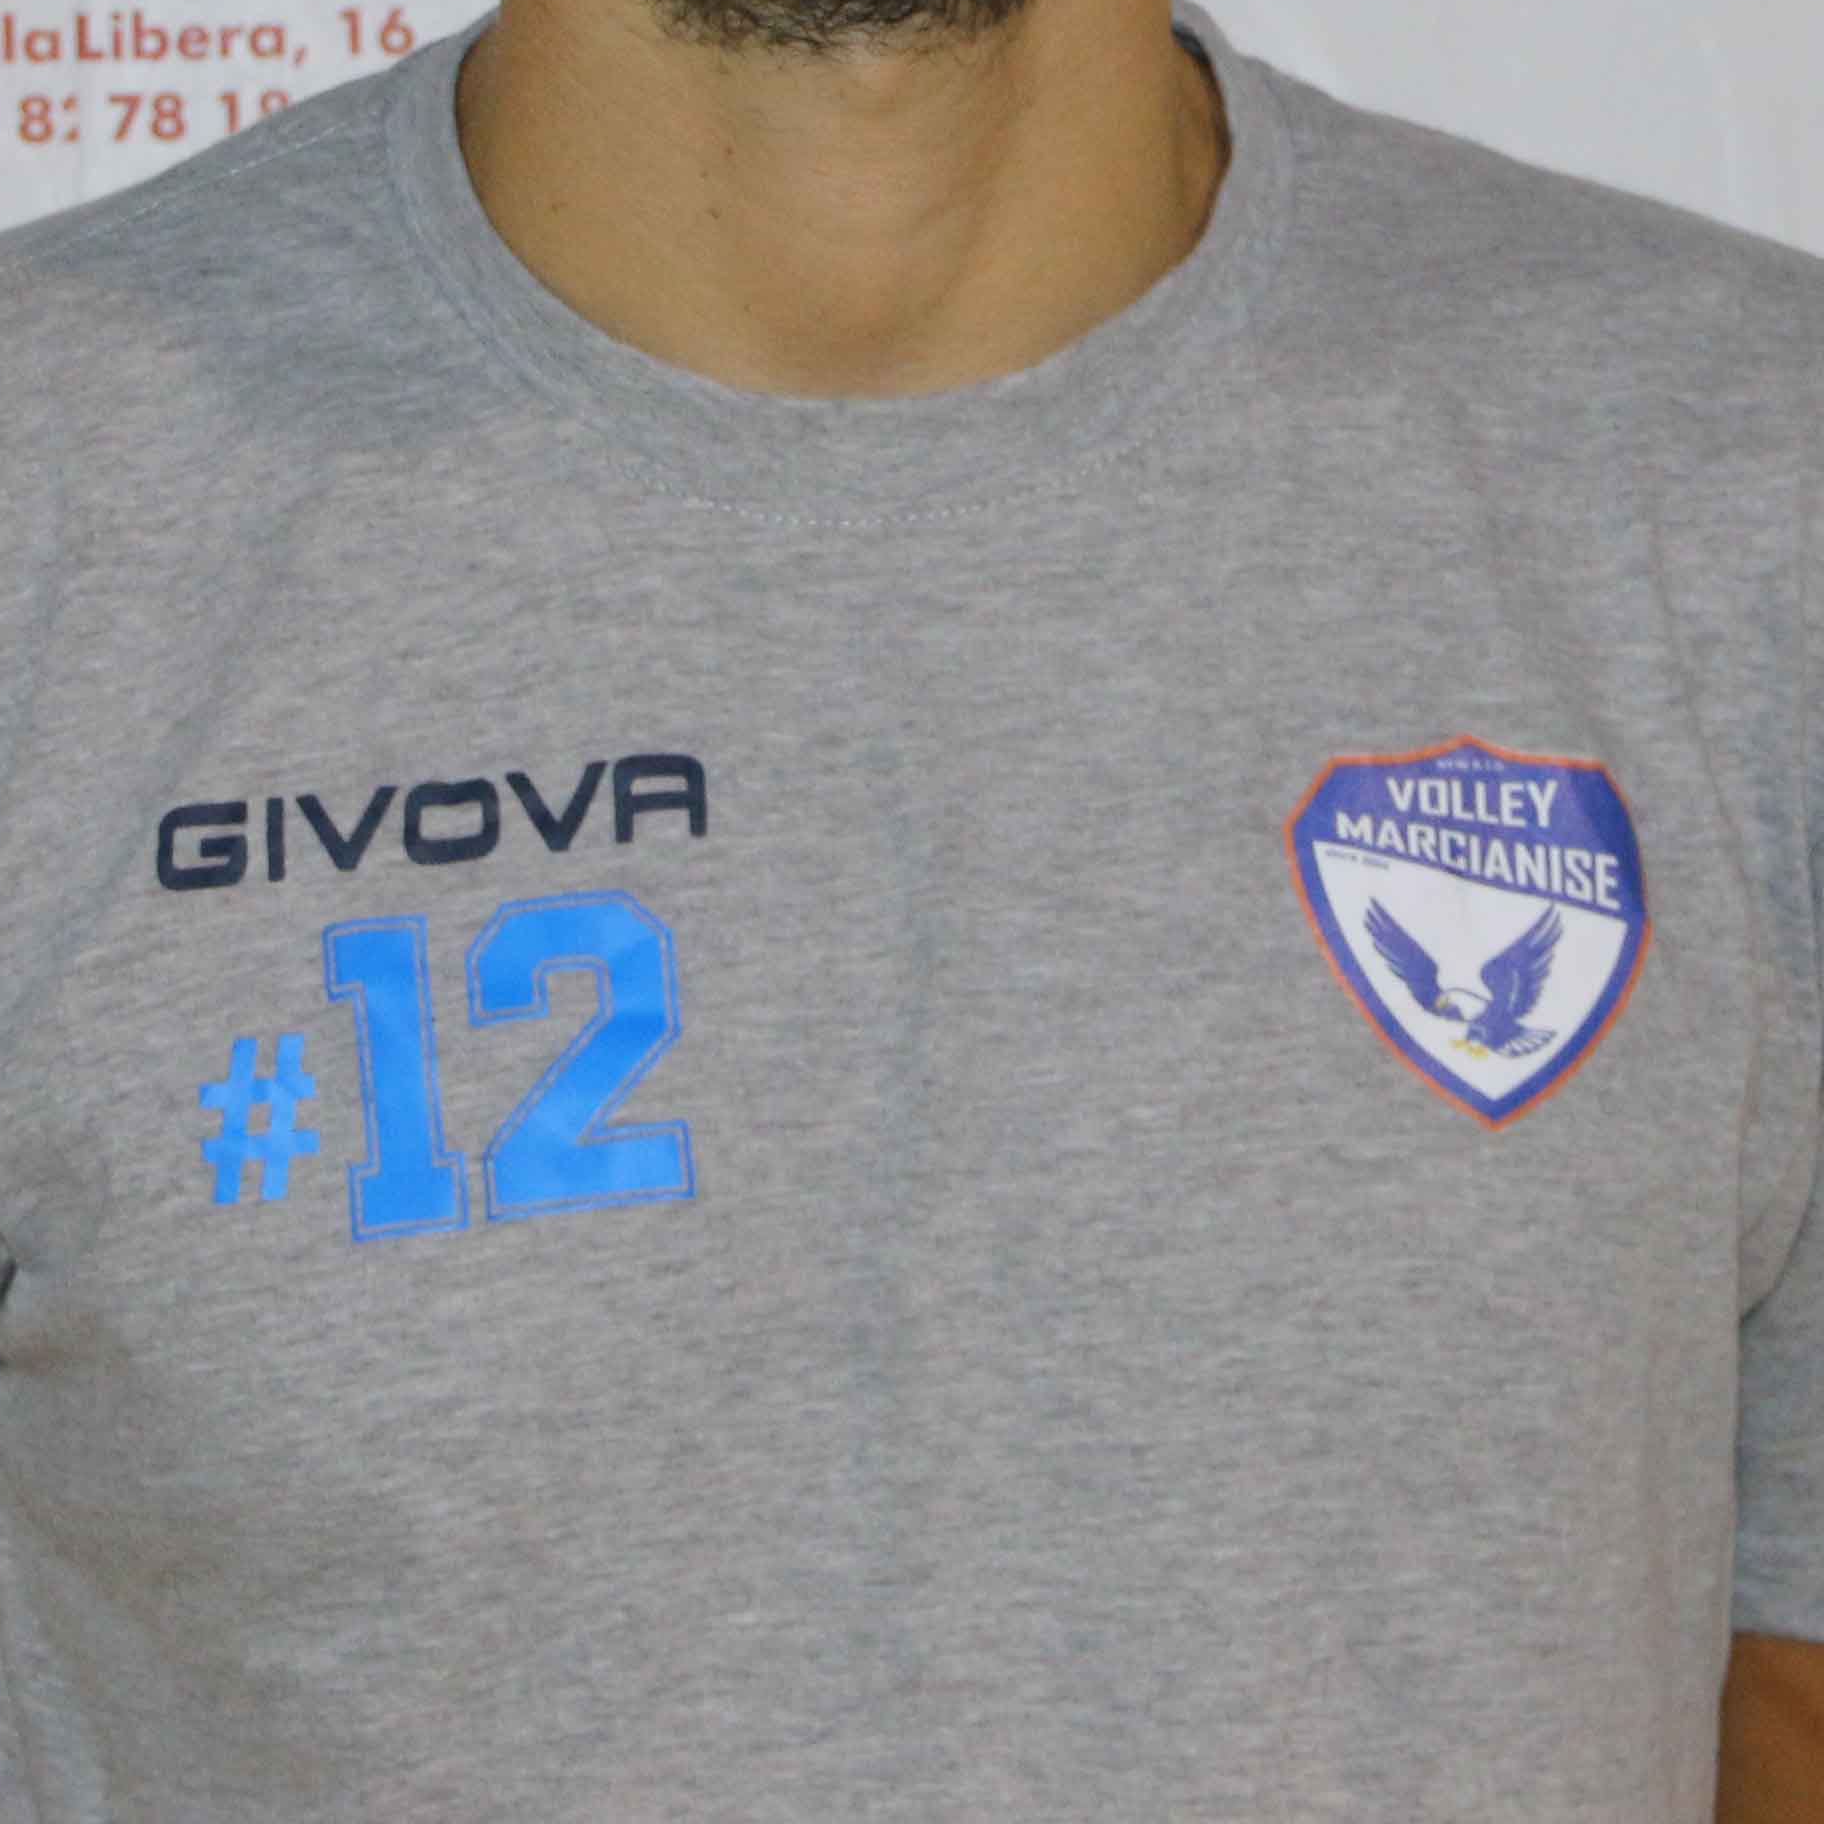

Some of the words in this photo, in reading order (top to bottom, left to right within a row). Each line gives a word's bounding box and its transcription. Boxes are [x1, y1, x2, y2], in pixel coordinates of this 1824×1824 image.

[340, 7, 415, 57] 16
[109, 91, 186, 142] 78
[157, 753, 708, 891] GIVOVA
[1386, 777, 1558, 828] VOLLEY
[1335, 811, 1621, 911] MARCIANISE
